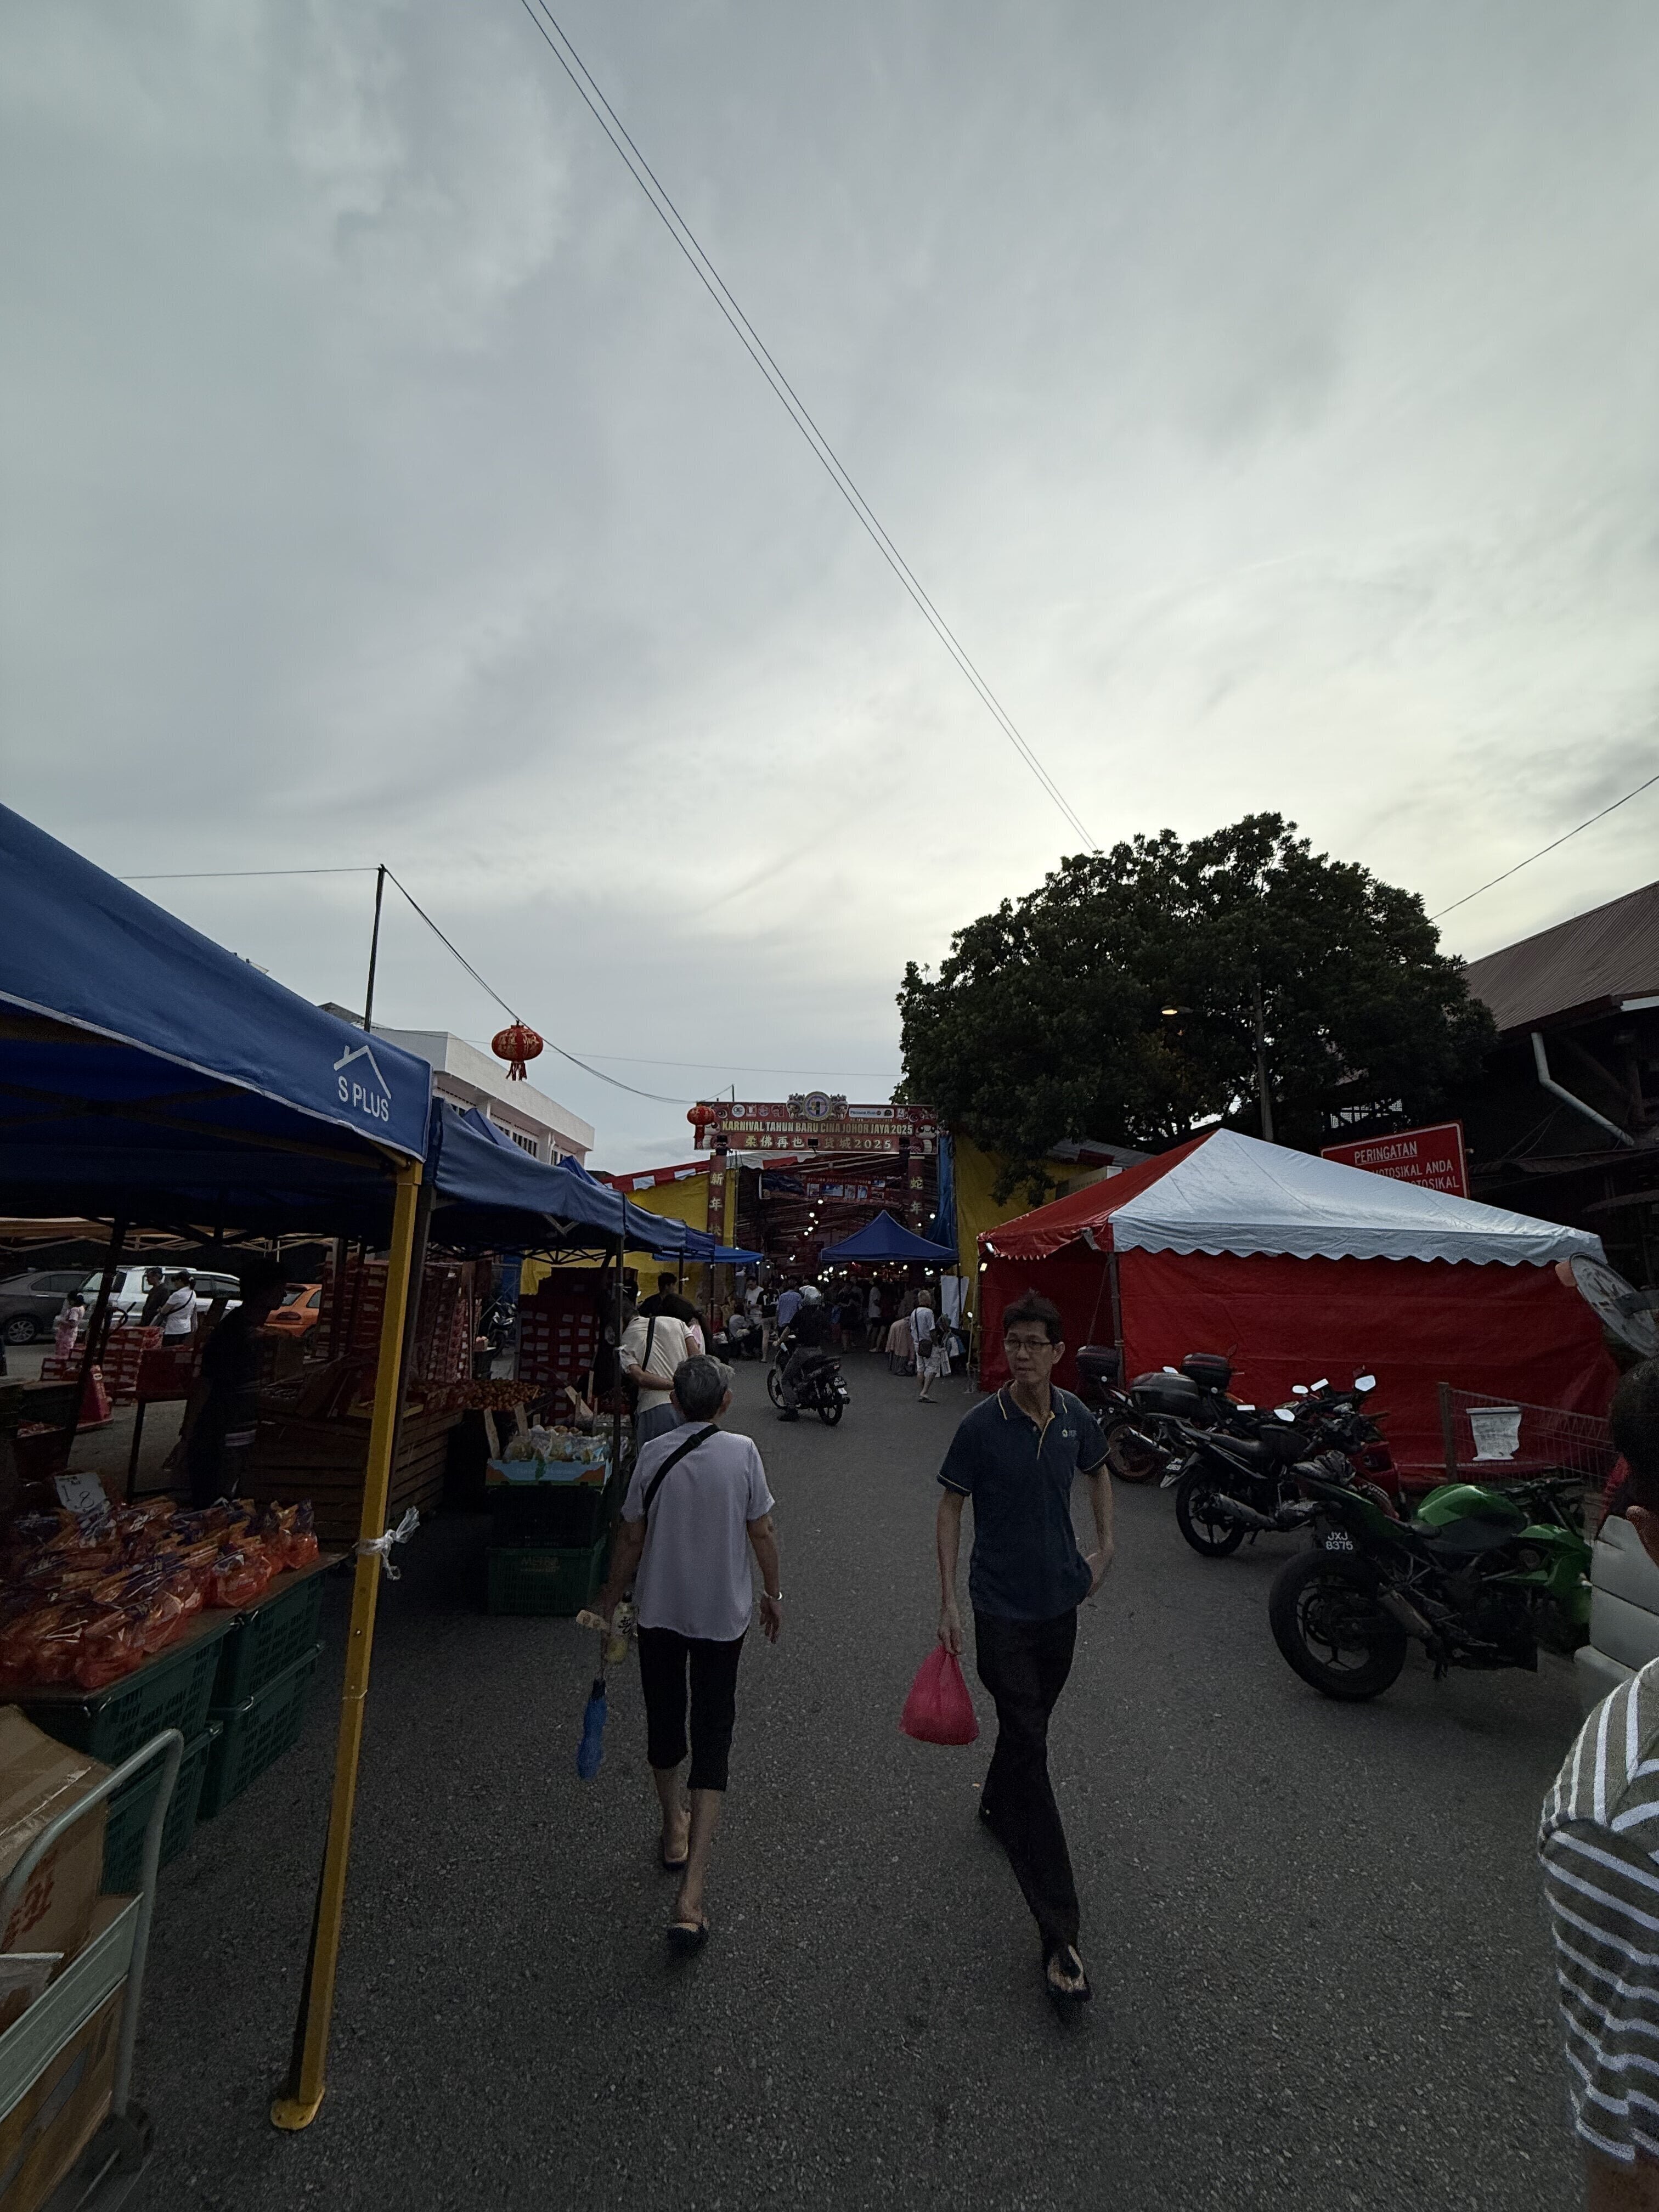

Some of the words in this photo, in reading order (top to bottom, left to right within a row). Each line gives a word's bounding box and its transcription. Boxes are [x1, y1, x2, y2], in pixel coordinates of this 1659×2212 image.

[338, 1075, 349, 1102] S
[353, 1082, 389, 1122] PLUS
[722, 1121, 764, 1132] KARNIVAL
[765, 1121, 794, 1132] TAHUN
[795, 1122, 819, 1133] BARU
[820, 1122, 840, 1133] CINA
[842, 1123, 869, 1134] JOHOR
[870, 1124, 889, 1135] JAYA
[891, 1124, 913, 1135] 2025
[745, 1135, 891, 1149] 柔佛再也货城2025
[1354, 1141, 1418, 1164] PERINGATAN
[1426, 1159, 1453, 1174] ANDA
[1328, 1531, 1348, 1541] JXJ
[1325, 1541, 1353, 1550] 8375
